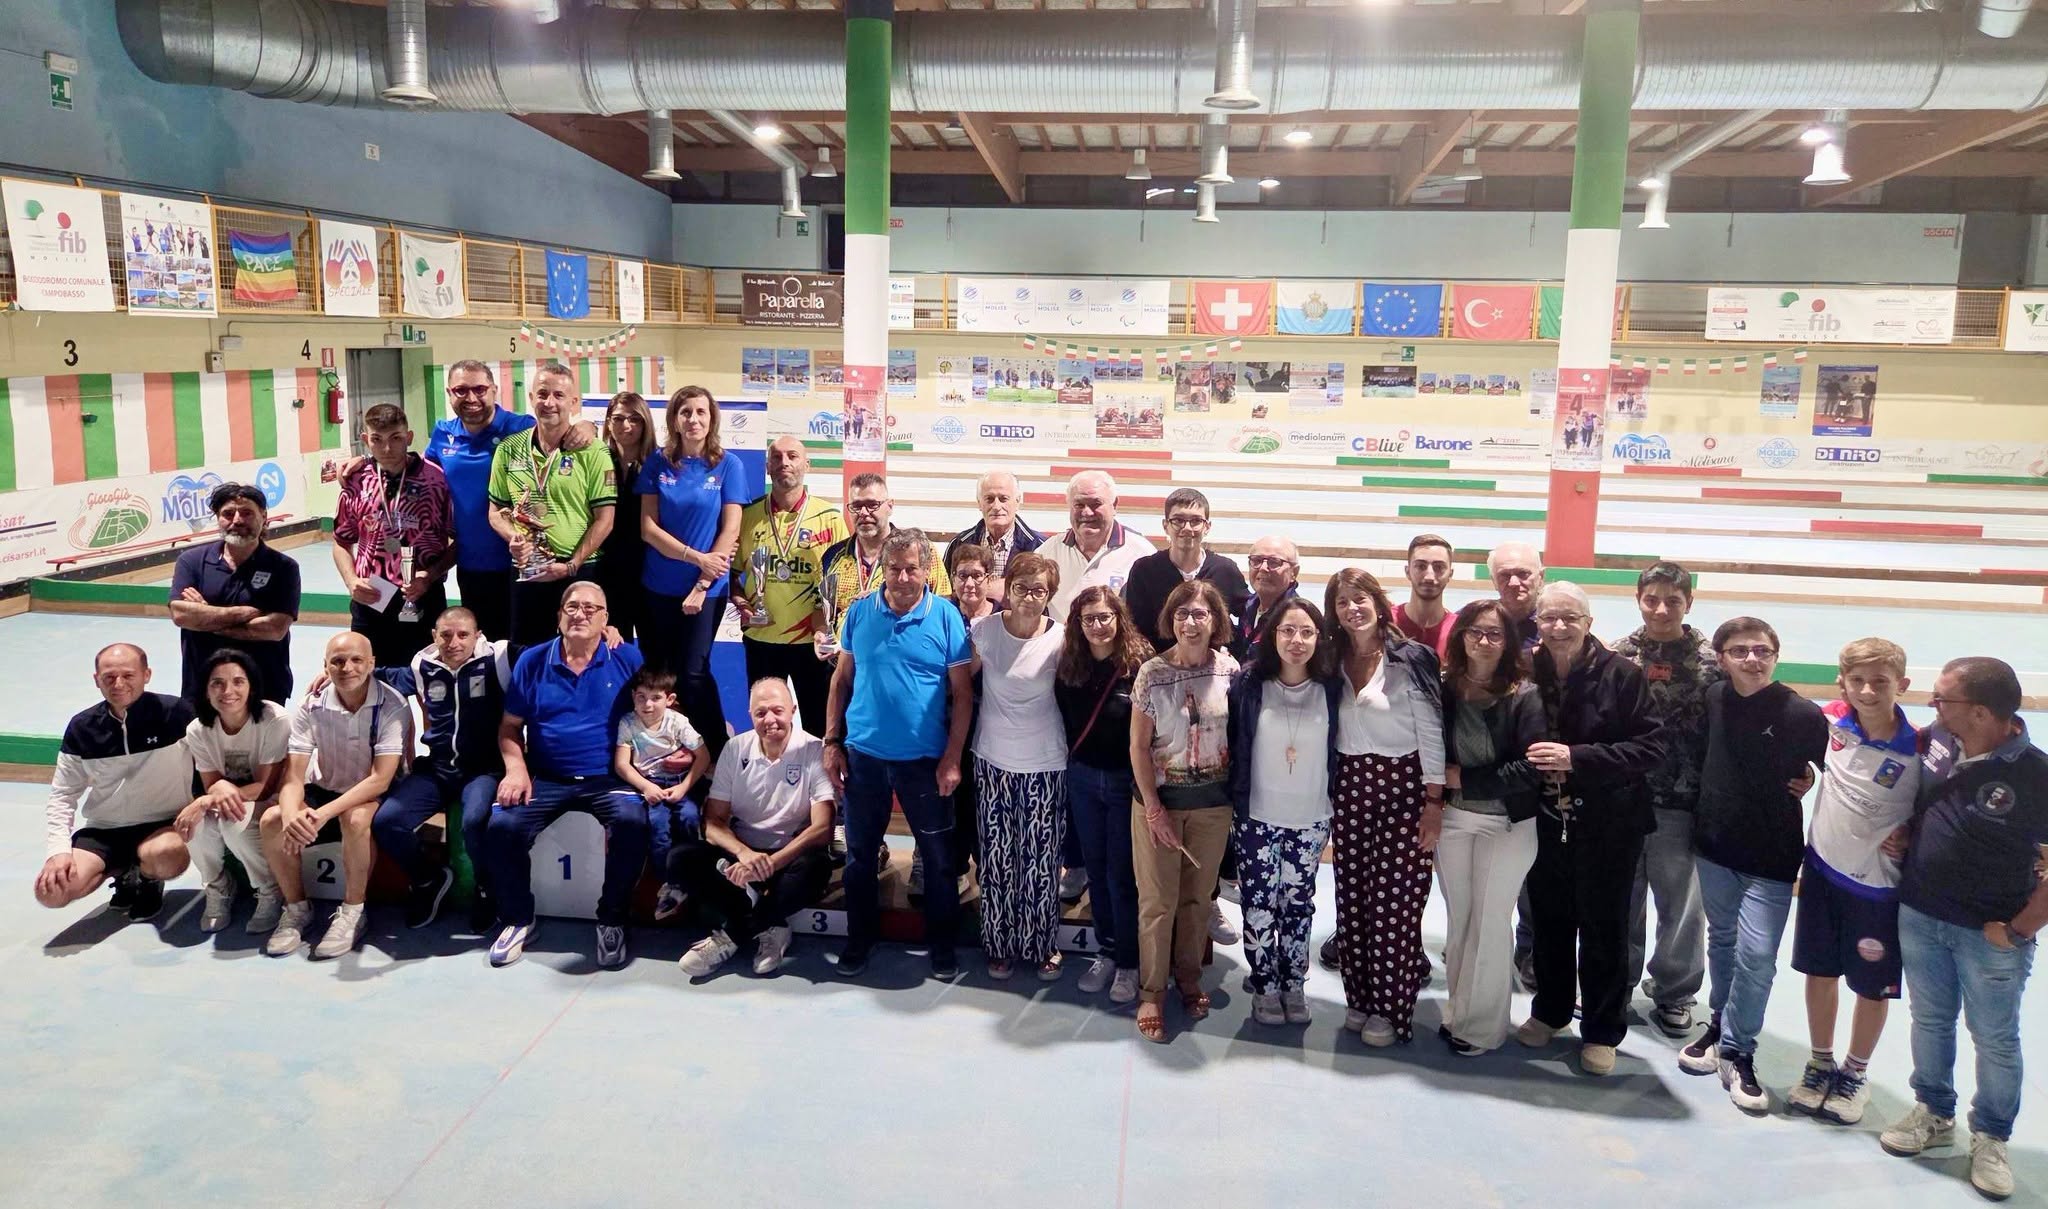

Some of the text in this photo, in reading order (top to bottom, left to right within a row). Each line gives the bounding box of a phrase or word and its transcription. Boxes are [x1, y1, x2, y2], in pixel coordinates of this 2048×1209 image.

[1924, 228, 1954, 236] USCITA
[58, 230, 87, 254] fib
[243, 254, 284, 273] PACE
[68, 277, 105, 286] COMUNALE
[327, 285, 373, 297] SPECIALE
[42, 288, 86, 298] CAMPOBASSO
[759, 292, 825, 311] Paparella
[1808, 313, 1841, 332] fib
[64, 340, 79, 366] 3
[301, 339, 311, 360] 4
[510, 337, 516, 353] 5
[1290, 433, 1346, 441] mediolanum
[1415, 435, 1473, 451] Barone
[316, 858, 336, 884] 2
[557, 854, 572, 880] 1
[811, 911, 828, 932] 3
[1071, 928, 1089, 949] 4
